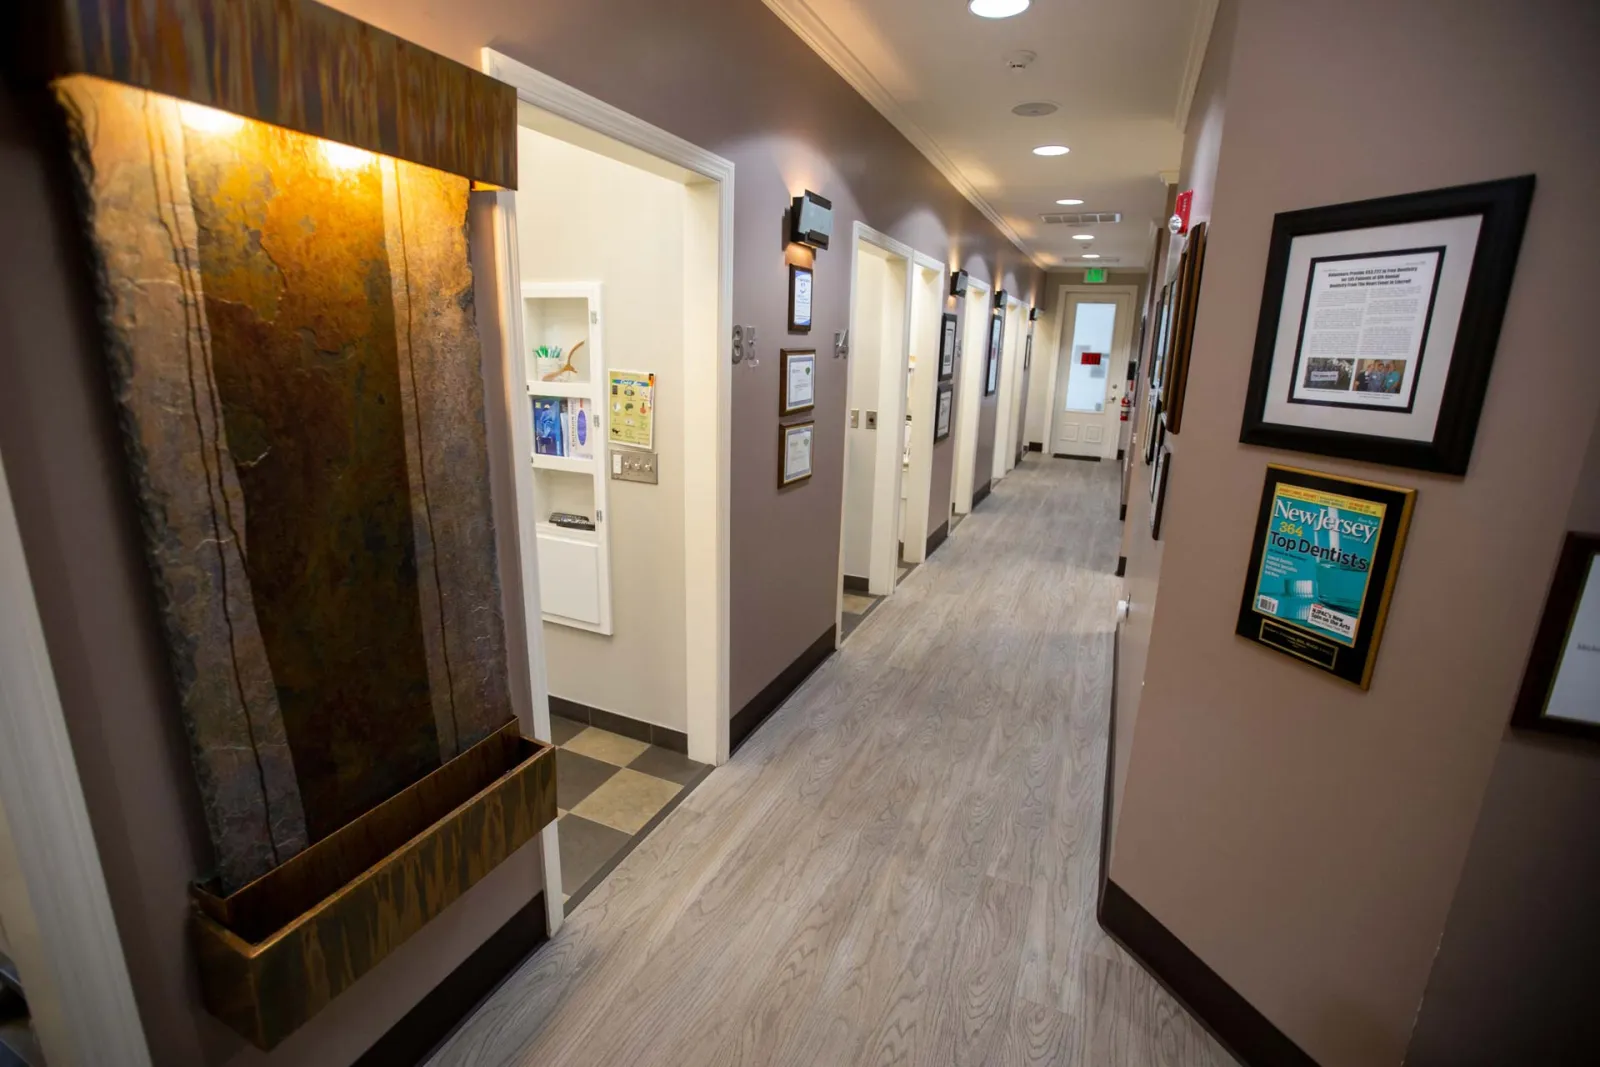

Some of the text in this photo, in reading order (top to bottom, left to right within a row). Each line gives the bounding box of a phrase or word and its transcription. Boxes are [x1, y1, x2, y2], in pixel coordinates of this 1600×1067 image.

[1274, 499, 1318, 526] New
[1314, 508, 1378, 544] Jersey
[1279, 521, 1303, 537] 364
[1270, 531, 1296, 551] Top
[1298, 538, 1368, 571] Dentists
